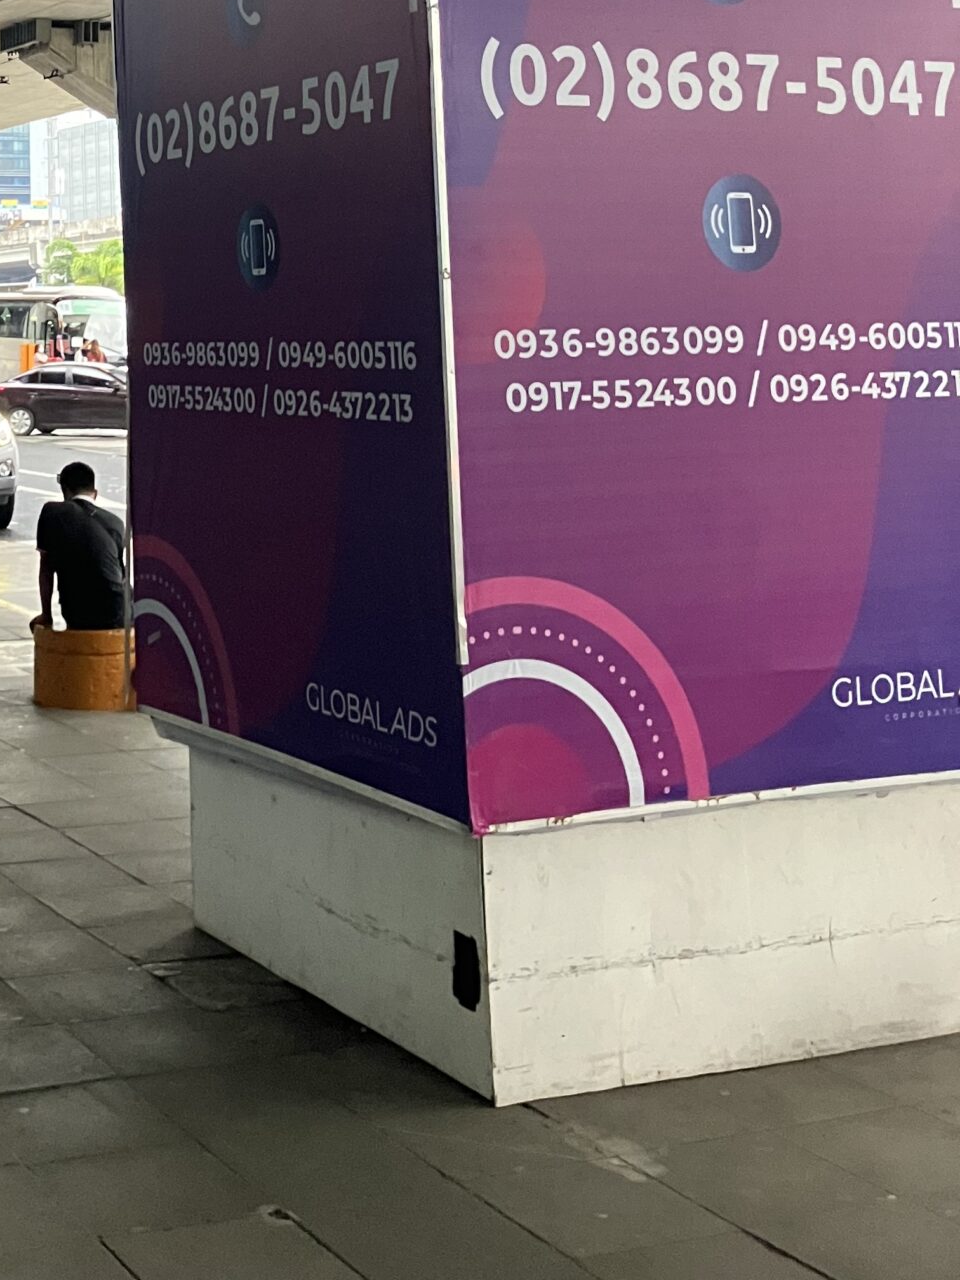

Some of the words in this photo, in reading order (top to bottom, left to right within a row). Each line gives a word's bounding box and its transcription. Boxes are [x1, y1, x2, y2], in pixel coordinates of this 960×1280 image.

[480, 36, 956, 122] (02)8687-5047
[135, 58, 399, 177] (02)8687-5047
[143, 341, 260, 368] 0936-9863099
[278, 341, 417, 370] 0949-6005116
[493, 325, 744, 360] 0936-9863099
[148, 384, 256, 414] 0917-5524300
[273, 389, 413, 423] 0926-4372213
[505, 375, 737, 413] 0917-5524300
[832, 668, 954, 708] GLOBAL
[306, 682, 389, 733] GLOBAL
[390, 707, 438, 747] ADS
